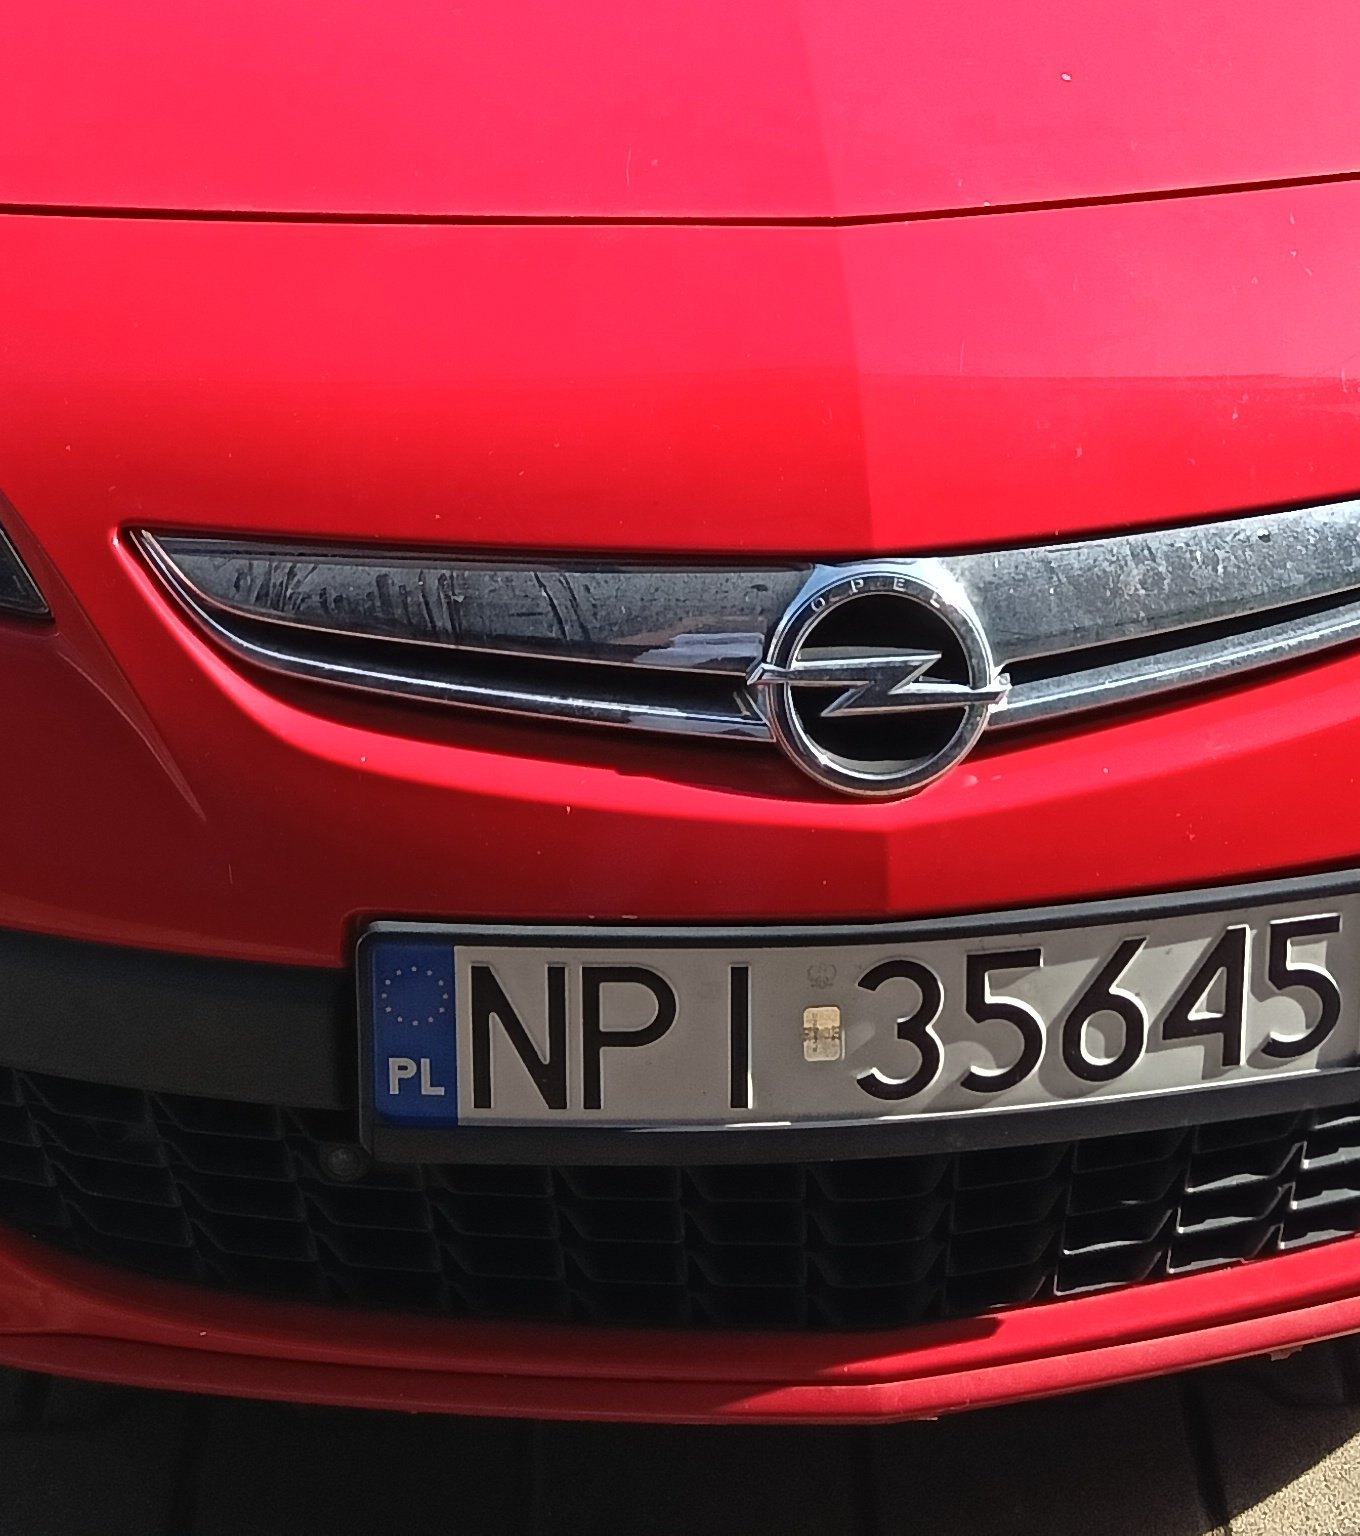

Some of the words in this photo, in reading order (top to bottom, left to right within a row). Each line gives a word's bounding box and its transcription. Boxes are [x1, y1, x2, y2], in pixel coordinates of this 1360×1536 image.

[810, 576, 941, 614] OPEL
[470, 964, 751, 1110] NPI
[856, 912, 1342, 1102] 35645
[388, 1057, 446, 1097] PL
